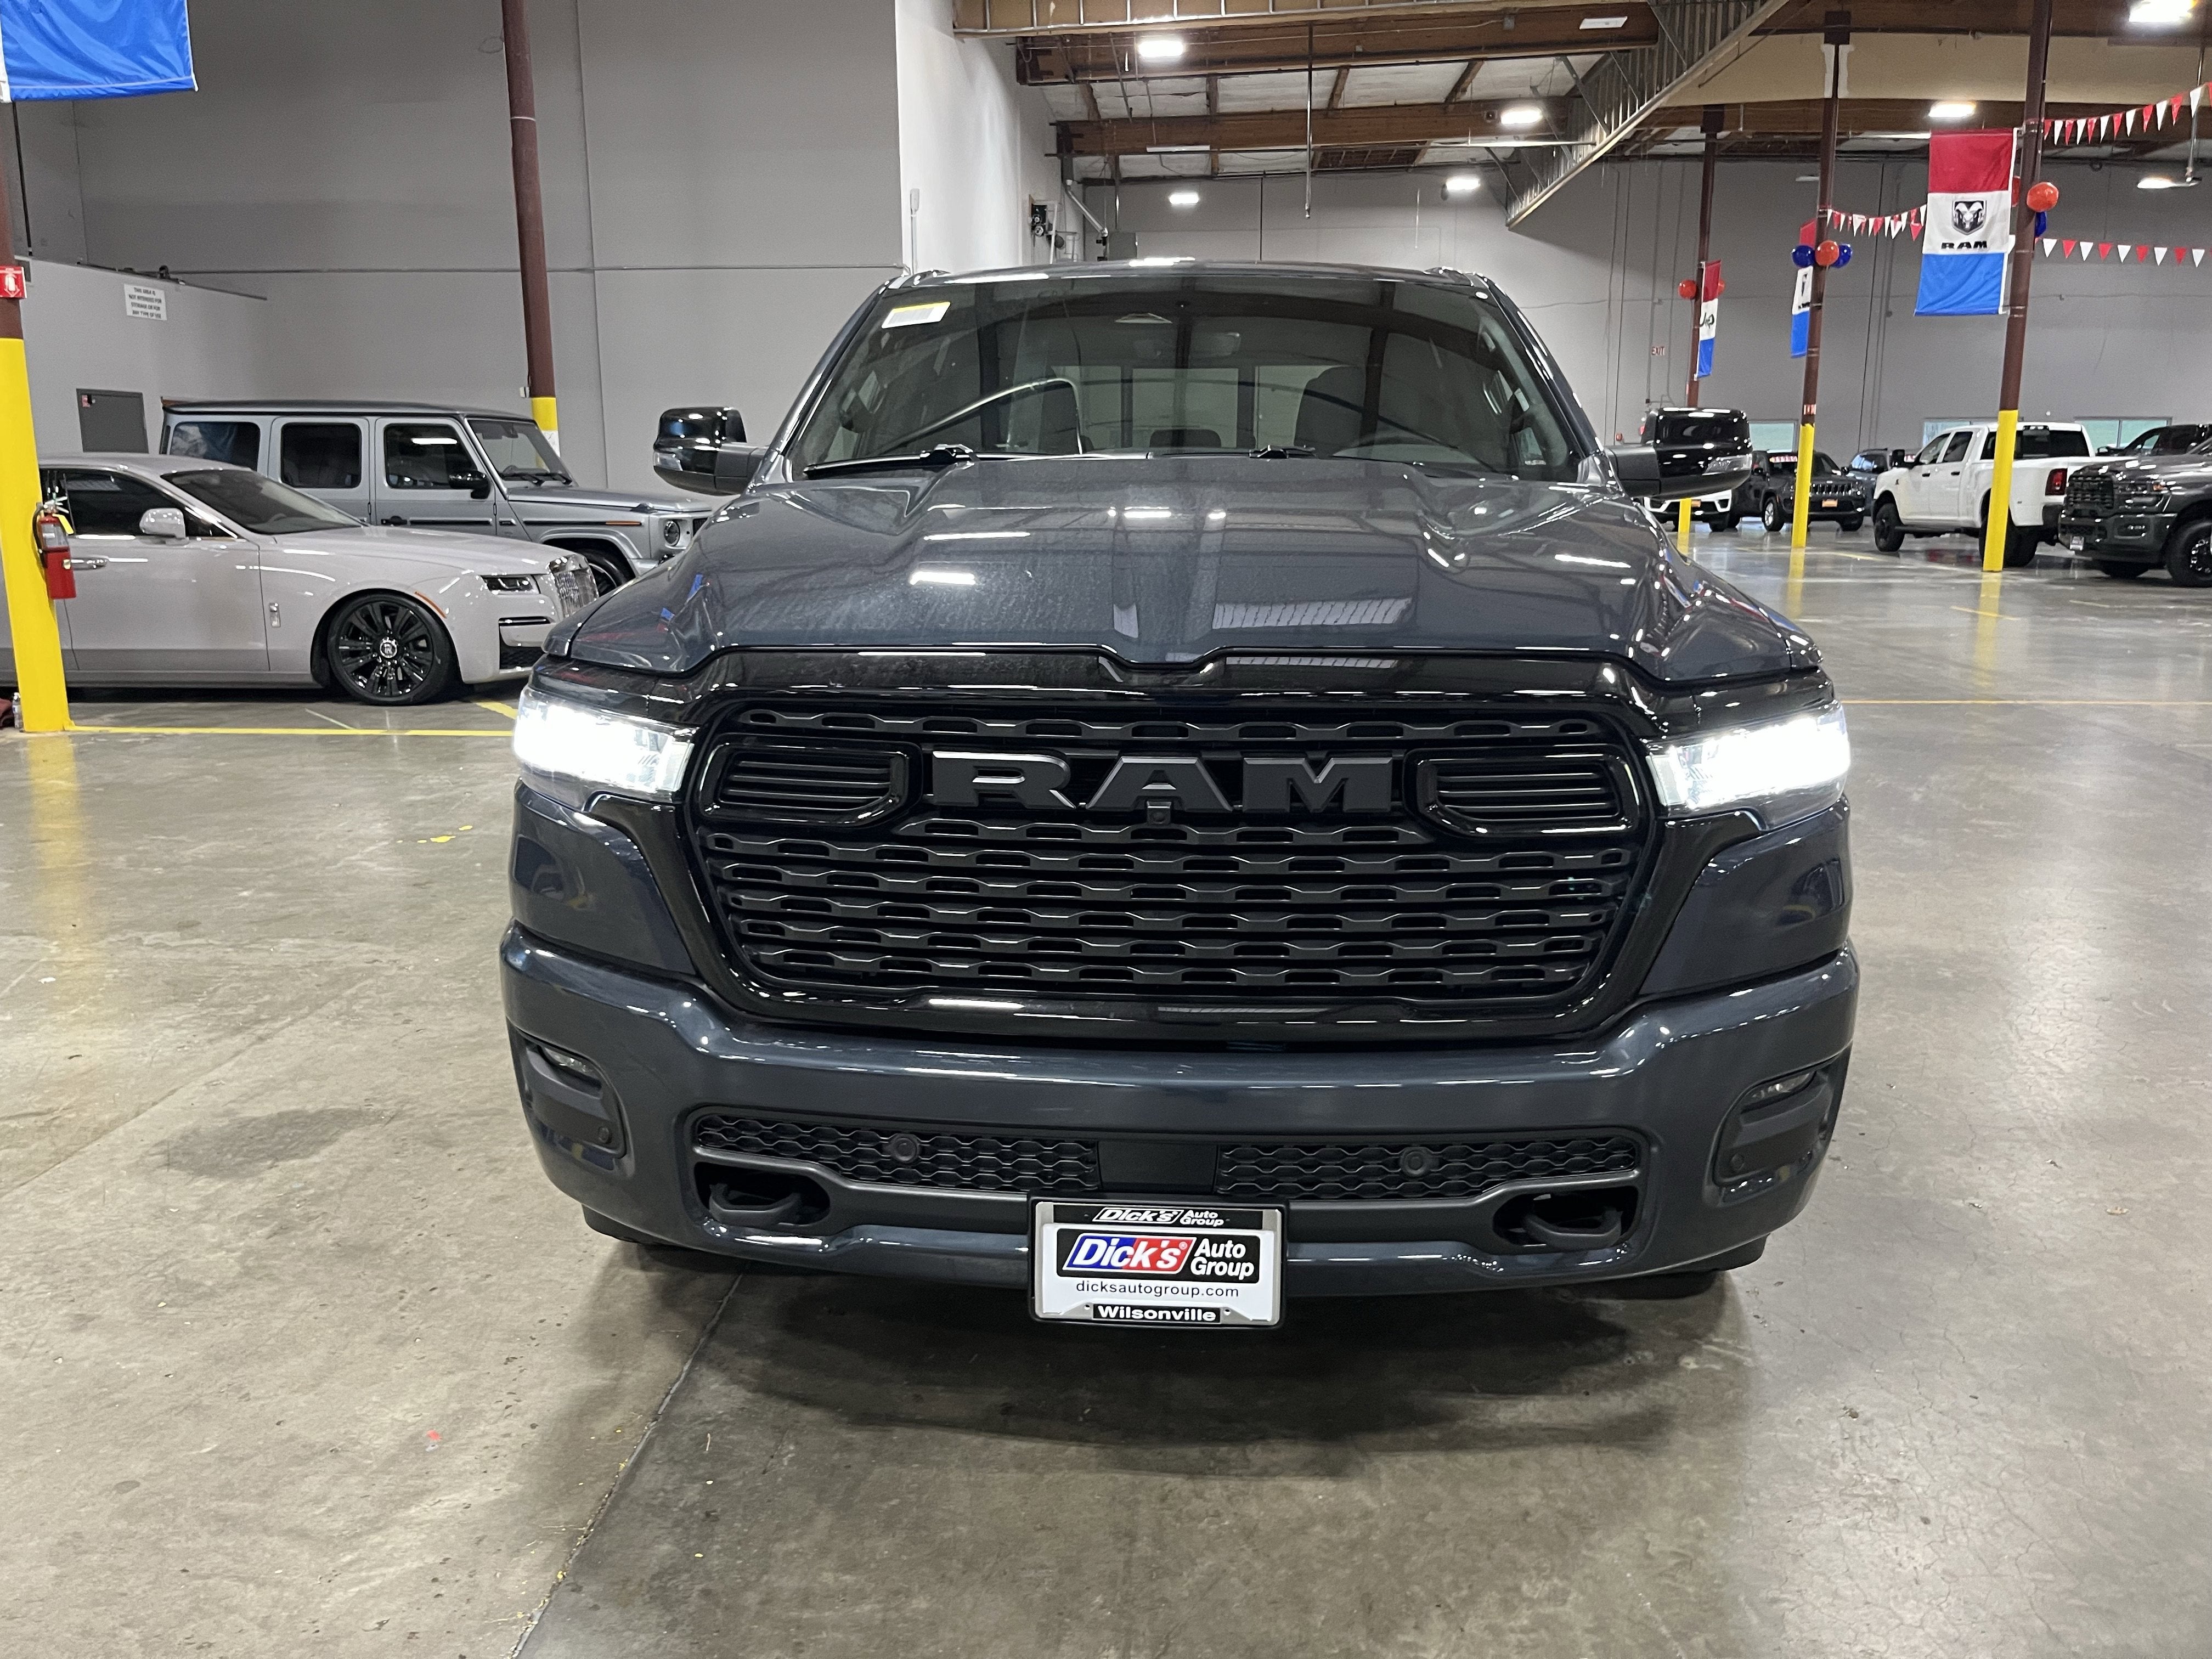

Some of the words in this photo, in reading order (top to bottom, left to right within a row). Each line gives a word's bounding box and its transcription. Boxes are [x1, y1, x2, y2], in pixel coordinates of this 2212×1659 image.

[1941, 240, 1987, 249] RAM
[1651, 346, 1664, 356] EXIT
[932, 751, 1393, 812] RAM
[1180, 1217, 1224, 1227] Group
[1185, 1210, 1218, 1219] Auto
[1072, 1237, 1181, 1270] Dick's
[1194, 1238, 1246, 1259] Auto
[1190, 1257, 1255, 1280] Group
[1076, 1280, 1239, 1297] dicksautogroup.com
[1097, 1305, 1216, 1322] Wilsonville
